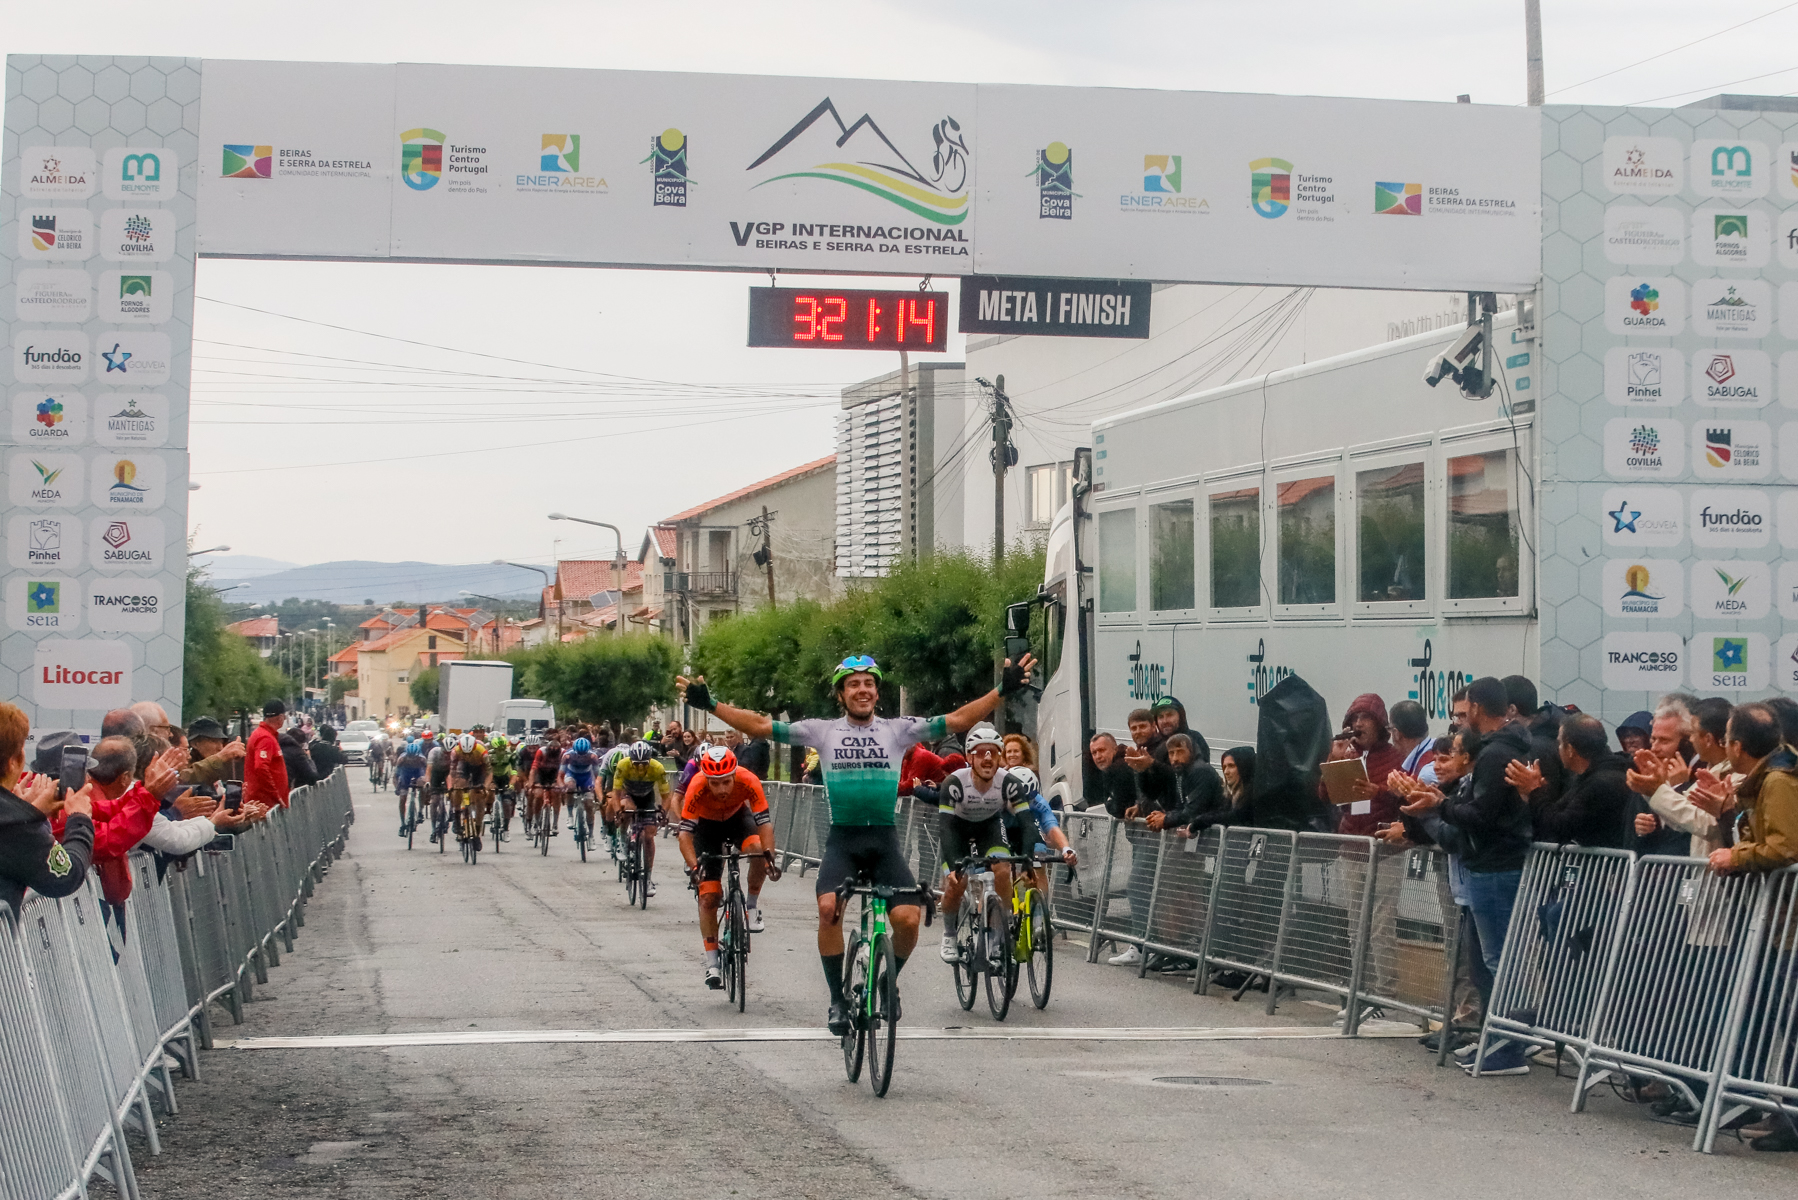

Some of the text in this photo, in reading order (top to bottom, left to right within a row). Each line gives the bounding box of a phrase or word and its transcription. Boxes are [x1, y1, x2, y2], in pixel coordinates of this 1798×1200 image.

[280, 149, 312, 157] BEIRAS
[450, 145, 487, 154] Turismo
[449, 154, 480, 163] Centro
[279, 159, 285, 167] E
[318, 160, 330, 168] DA
[332, 160, 372, 169] ESTRELA
[279, 169, 371, 178] COMUNIDADE INTERMUNICIPAL
[449, 164, 488, 175] Portugal
[1614, 168, 1674, 178] ALMEIDA
[31, 175, 86, 184] ALMEIDA
[1297, 174, 1333, 184] Turismo
[121, 184, 160, 192] BELMONTE
[656, 183, 685, 194] Cova
[1297, 184, 1327, 192] Centro
[1711, 180, 1752, 189] BELMONTE
[1429, 187, 1459, 196] BEIRAS
[655, 193, 686, 204] Beira
[1041, 196, 1070, 207] Cova
[1297, 193, 1335, 204] Portugal
[1436, 197, 1464, 206] SERRA
[1465, 198, 1477, 206] DA
[1479, 199, 1516, 208] ESTRELA
[1041, 206, 1071, 217] Beira
[1428, 207, 1466, 215] COMUNIDADE
[57, 234, 83, 242] CELORICO
[729, 221, 969, 247] V GP INTERNACIONAL
[120, 243, 154, 252] COVILHÃ
[755, 239, 969, 256] BEIRAS E SERRA DA ESTRELA
[978, 290, 1131, 326] META FINISH
[1707, 309, 1757, 322] MANTEIGAS
[1623, 317, 1666, 327] GUARDA
[23, 345, 81, 365] fundão
[127, 361, 166, 369] GOUVEIA
[1627, 386, 1662, 397] Pinhel
[1707, 386, 1758, 398] SABUGAL
[108, 420, 155, 431] MANTEIGAS
[29, 429, 69, 437] GUARDA
[1733, 450, 1760, 458] CELORICO
[1626, 456, 1662, 467] COVILHÃ
[1700, 506, 1762, 528] fundão
[1637, 520, 1678, 530] GOUVEIA
[28, 550, 61, 560] Pinhel
[104, 550, 152, 560] SABUGAL
[93, 595, 158, 606] TRANCOSO
[1621, 605, 1658, 613] PENAMACOR
[26, 615, 59, 626] seia
[1608, 652, 1678, 664] TRANCOSO
[1638, 663, 1678, 671] MUNICÍPIO
[43, 665, 123, 685] Litocar
[1712, 675, 1747, 687] seia
[841, 737, 880, 748] CAJA
[833, 748, 889, 760] RURAL
[831, 761, 891, 770] SEGUROS RGA
